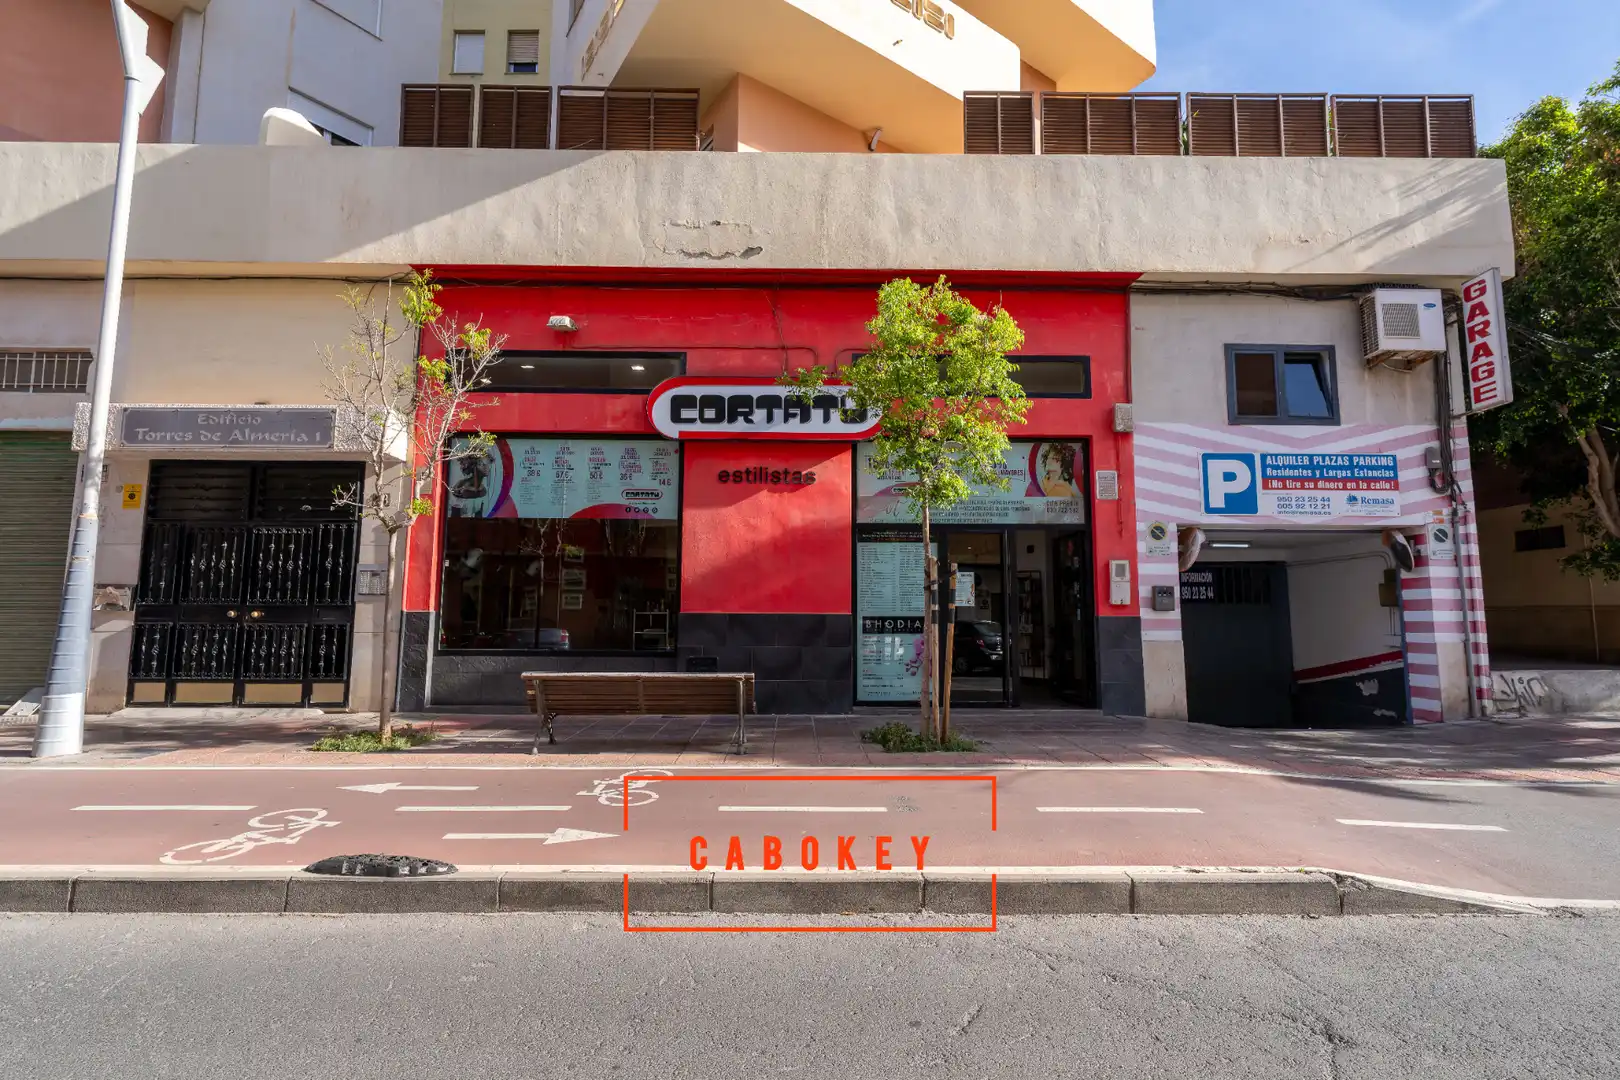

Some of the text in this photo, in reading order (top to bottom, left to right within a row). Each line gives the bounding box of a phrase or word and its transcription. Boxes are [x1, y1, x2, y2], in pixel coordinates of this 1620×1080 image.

[1463, 279, 1497, 404] GARAGE
[670, 394, 868, 425] CORTATU
[197, 412, 262, 425] Edificio
[135, 427, 193, 441] Torres
[200, 430, 222, 442] de
[228, 428, 309, 442] Almería
[1266, 455, 1394, 466] ALQUILER PLAZAS PARKING
[717, 466, 817, 485] estilistas
[1266, 467, 1395, 478] Residentes y Largas Estancias
[1206, 459, 1252, 508] P
[1286, 480, 1301, 489] tire
[1304, 481, 1315, 489] su
[1317, 480, 1343, 489] dinero
[1359, 480, 1368, 489] la
[1361, 496, 1395, 505] Remasa
[1181, 586, 1214, 599] 950 23 25 44
[866, 619, 922, 628] BHODIA
